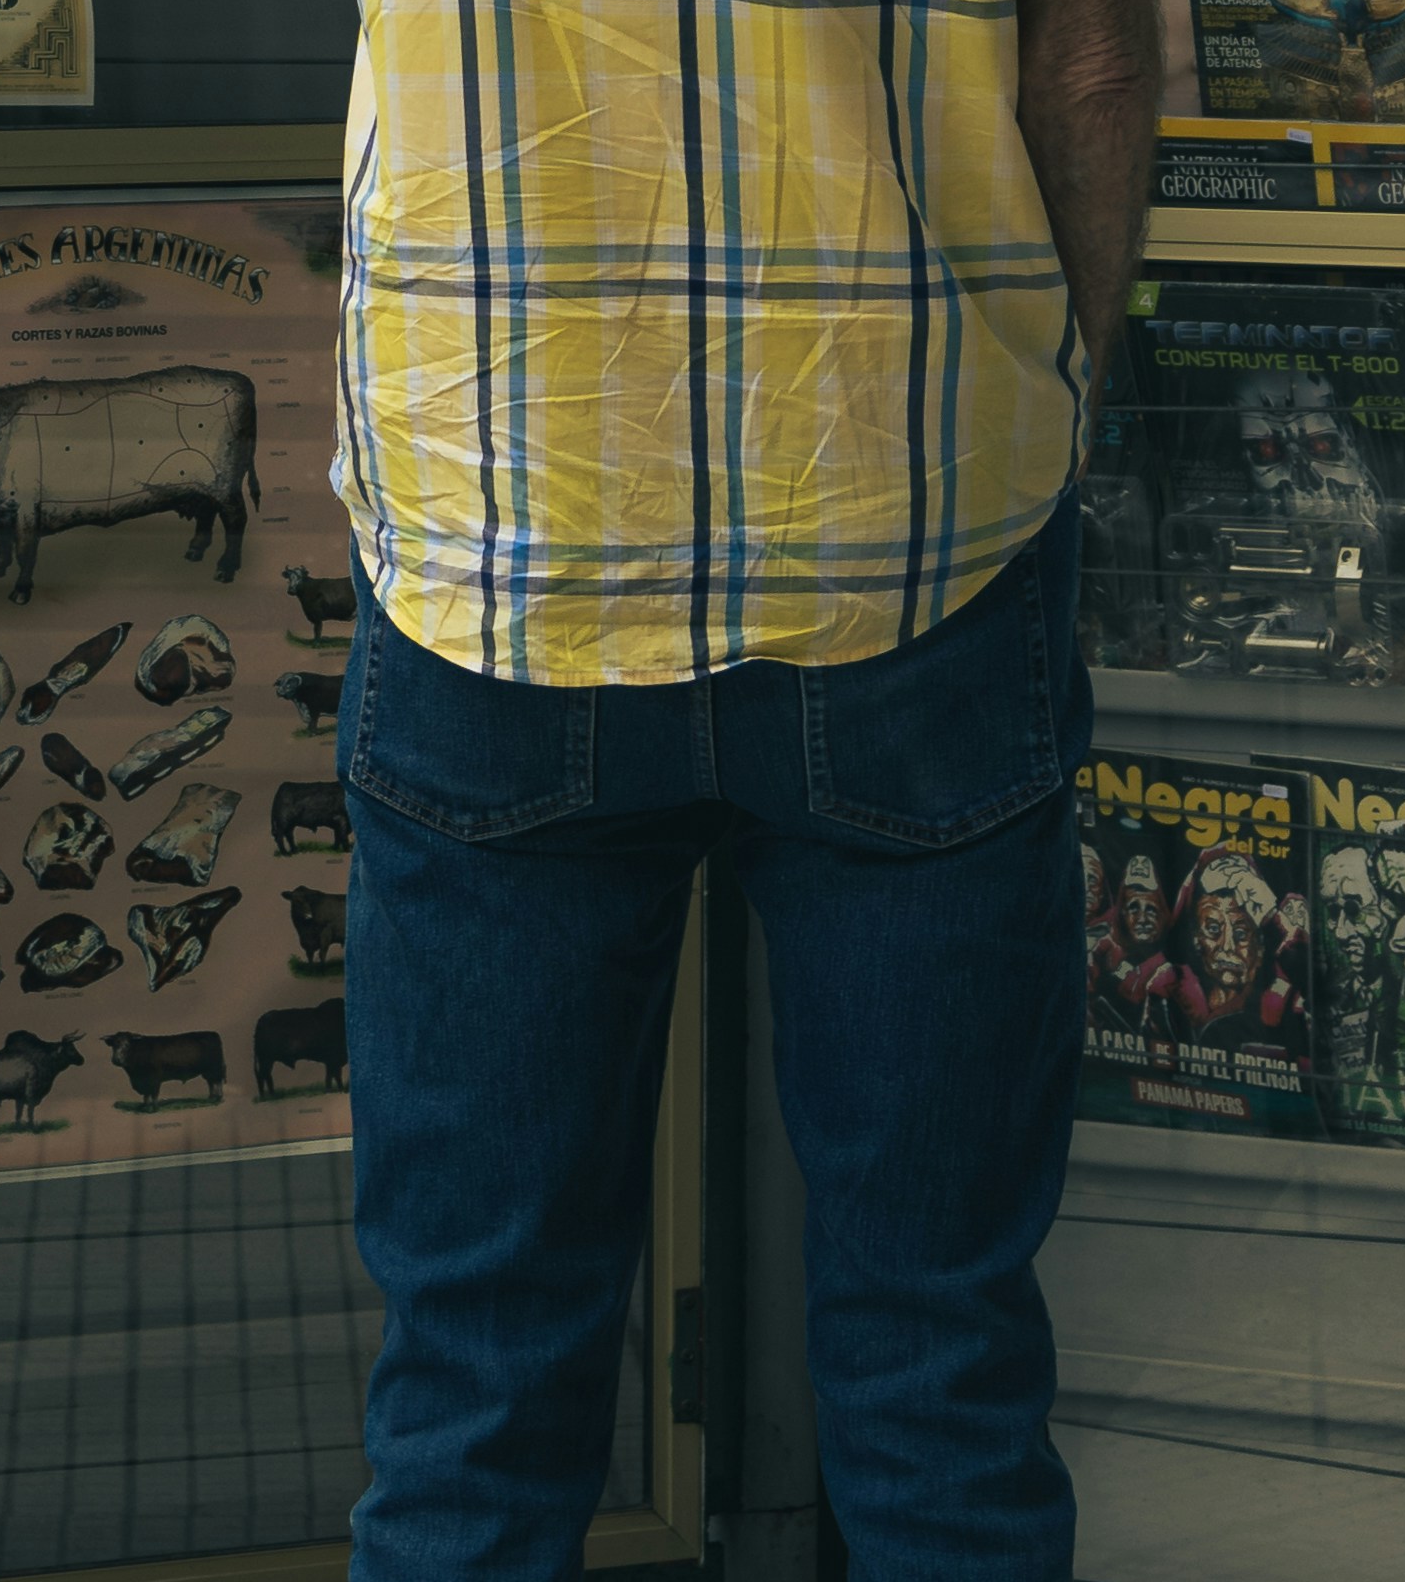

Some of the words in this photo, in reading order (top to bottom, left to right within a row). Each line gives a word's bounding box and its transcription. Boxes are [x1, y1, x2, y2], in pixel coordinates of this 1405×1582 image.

[1205, 47, 1216, 57] EL
[1219, 47, 1259, 58] TEATRO
[1206, 58, 1220, 68] DE
[1222, 58, 1262, 69] ATENAS
[1161, 177, 1276, 200] GEOGRAPHIC
[50, 225, 271, 305] ARGENTINAS
[11, 330, 60, 342] CORTES
[64, 329, 72, 340] Y
[76, 327, 112, 340] RAZAS
[116, 324, 167, 337] BOVINAS
[1145, 320, 1394, 349] TERMINATOR
[1155, 349, 1289, 372] CONSTRUYE
[1295, 355, 1322, 371] EL
[1327, 353, 1399, 374] T-800
[1370, 412, 1405, 430] 1:2
[1096, 761, 1291, 848] Negra
[1226, 835, 1254, 855] del
[1258, 840, 1291, 859] Sur
[1138, 1081, 1193, 1108] PANAMÁ
[1194, 1090, 1244, 1116] PAPERS
